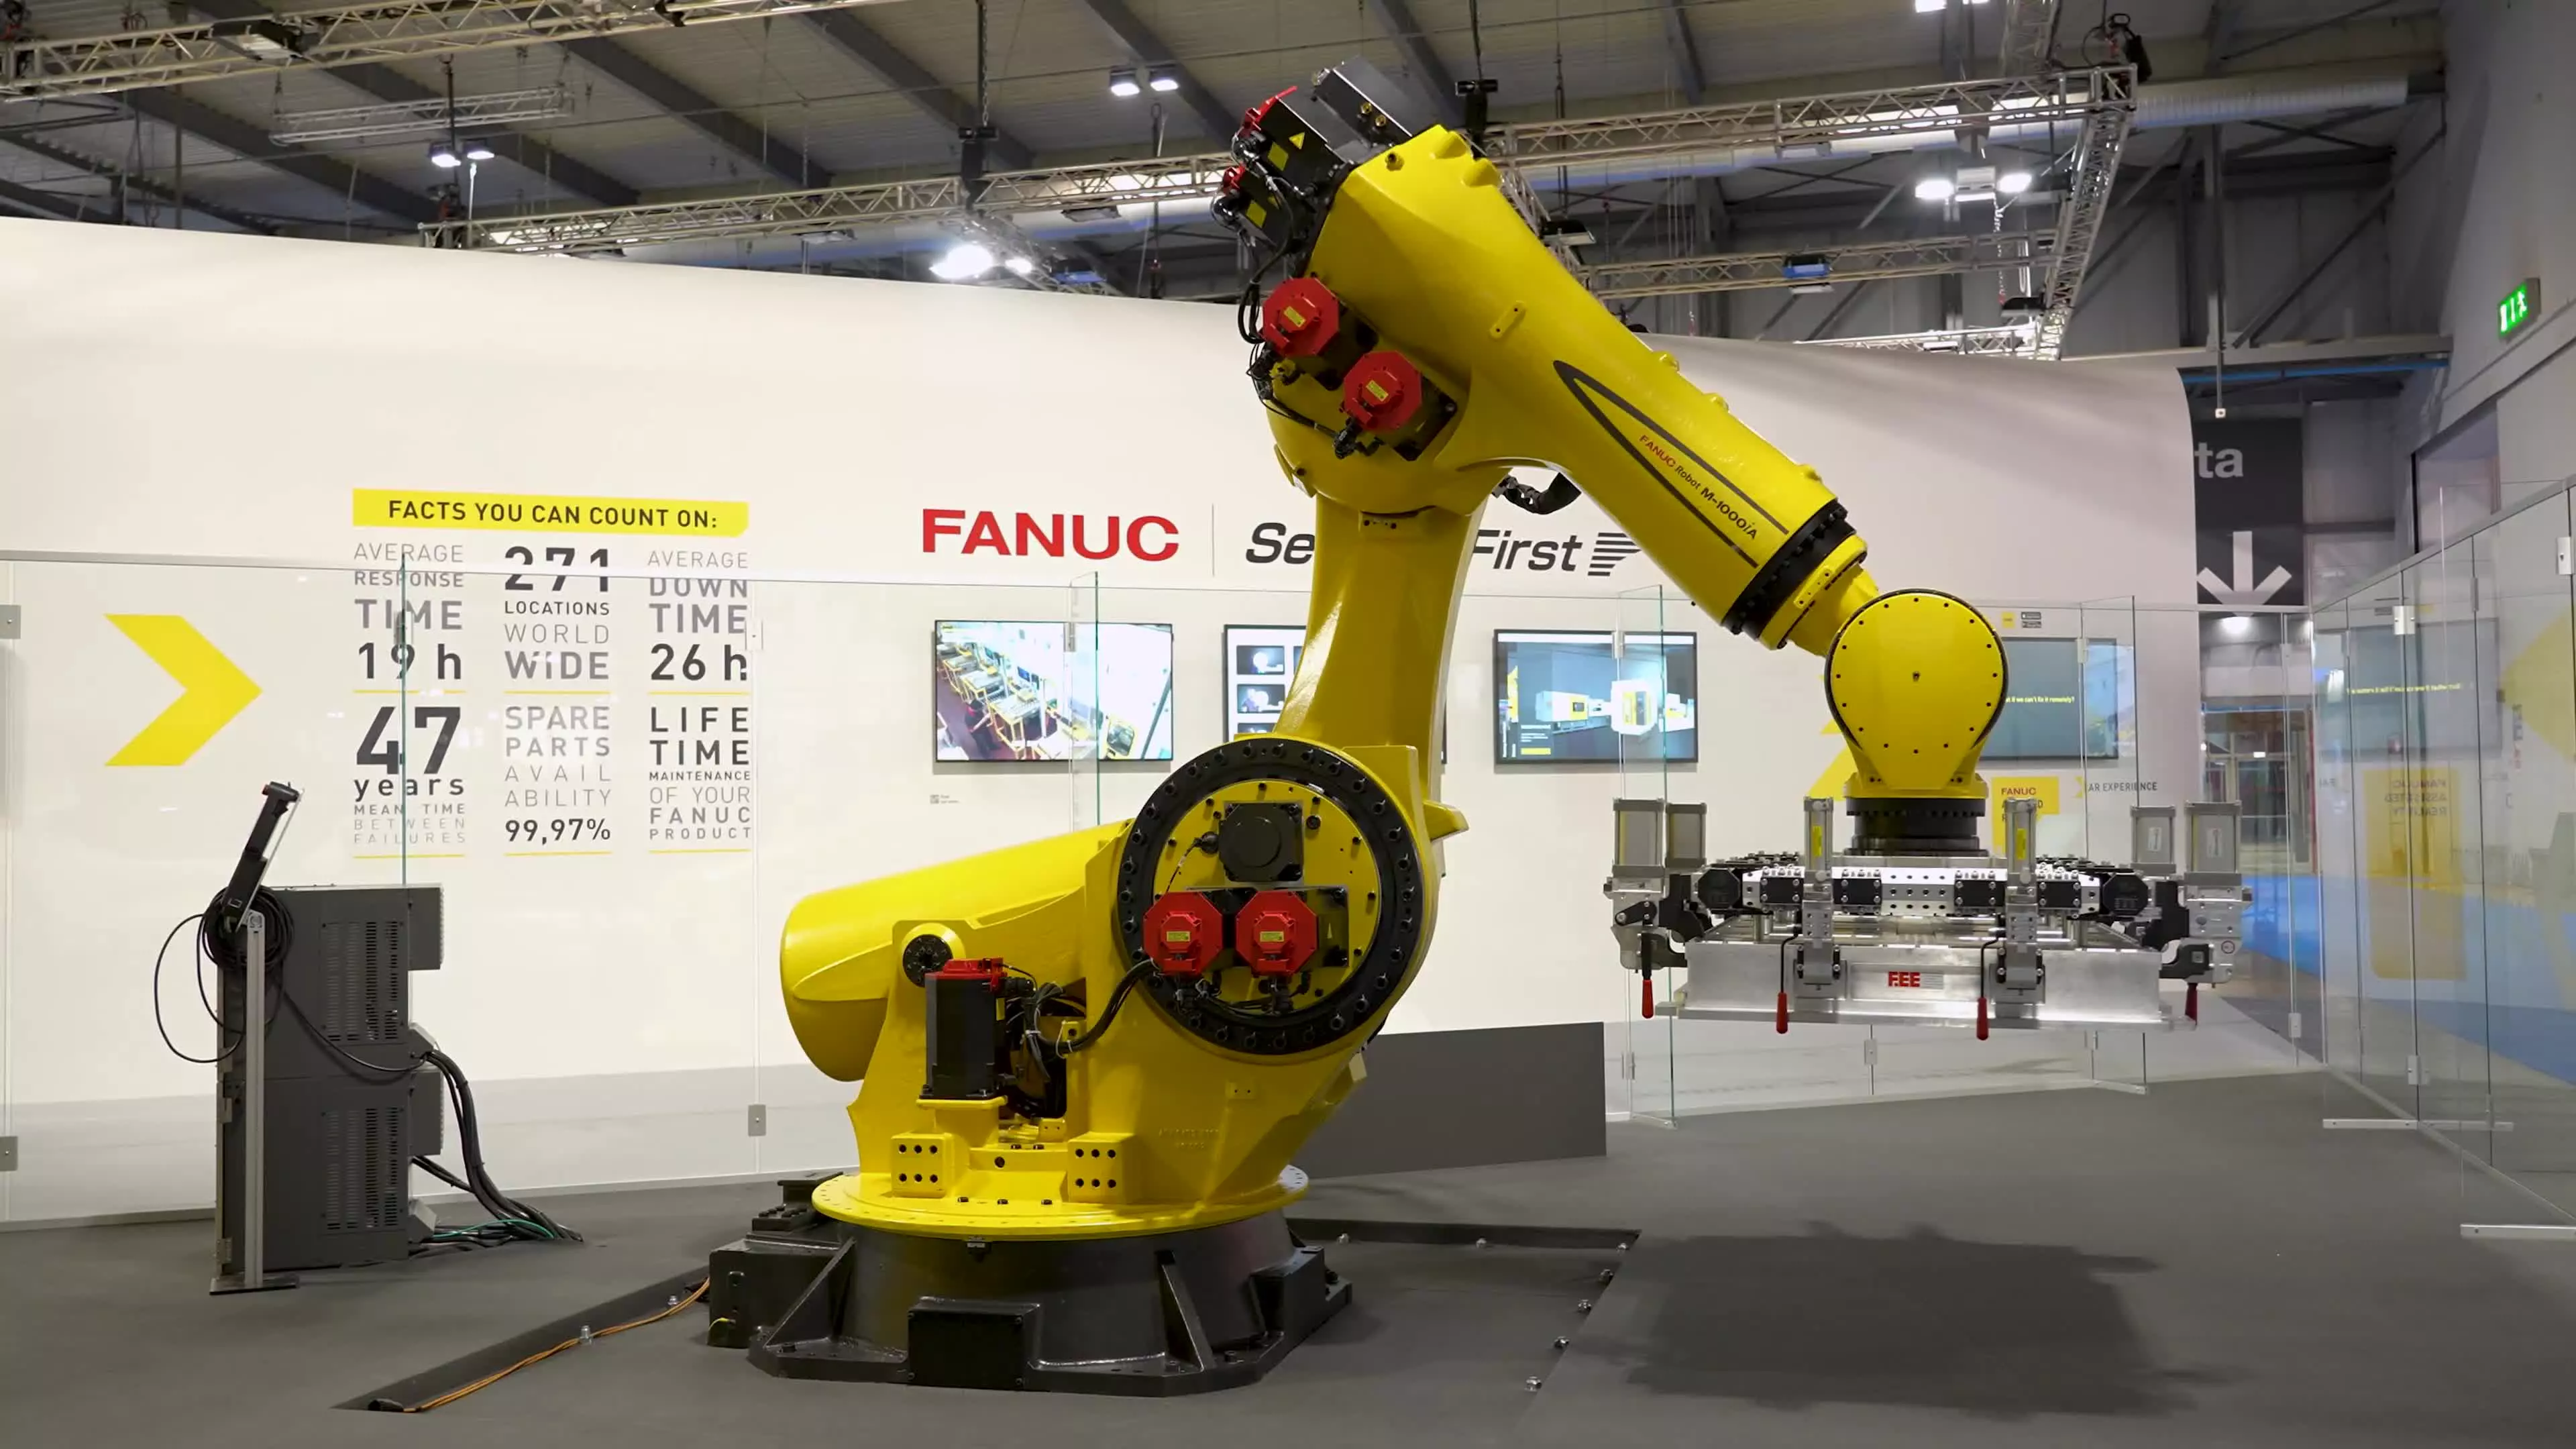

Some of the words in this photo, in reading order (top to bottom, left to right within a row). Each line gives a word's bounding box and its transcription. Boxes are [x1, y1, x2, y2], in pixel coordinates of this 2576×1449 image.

[2194, 442, 2243, 478] ta
[1639, 435, 1676, 467] FANUC
[1674, 465, 1701, 490] Robot
[1701, 487, 1757, 539] M-1000iA
[388, 500, 466, 521] FACTS
[475, 503, 523, 522] YOU
[532, 504, 580, 523] CAN
[590, 506, 669, 526] COUNT
[678, 510, 716, 528] ON:
[922, 508, 1179, 561] FANUC
[354, 543, 464, 562] AVERAGE
[1246, 523, 1315, 564] Se
[1472, 529, 1583, 572] First
[504, 546, 608, 592] 271
[647, 550, 749, 568] AVERAGE
[649, 578, 747, 598] DOWN
[354, 598, 463, 630] TIME
[504, 600, 609, 615] LOCATIONS
[649, 604, 747, 633] TIME
[504, 623, 608, 644] WORLD
[359, 642, 415, 679] 19
[437, 643, 462, 680] h
[504, 651, 608, 680] WIDE
[651, 643, 706, 680] 26
[724, 644, 747, 680] h
[505, 706, 610, 730] SPARE
[651, 706, 749, 732] LIFE
[356, 706, 461, 774] 47
[506, 737, 610, 757] PARTS
[649, 740, 749, 765] TIME
[504, 765, 611, 782] AVAIL
[649, 771, 751, 781] MAINTENANCE
[354, 778, 464, 802] years
[504, 789, 610, 806] ABILITY
[649, 787, 678, 804] OF
[692, 786, 750, 804] YOUR
[2001, 788, 2037, 796] FANUC
[2088, 783, 2100, 792] AR
[354, 804, 404, 815] MEAN
[423, 804, 465, 814] TIME
[650, 806, 750, 824] FANUC
[354, 818, 465, 830] BETWEEN
[505, 818, 610, 845] 99,97%
[649, 827, 751, 840] PRODUCT
[354, 833, 465, 844] FAILURES
